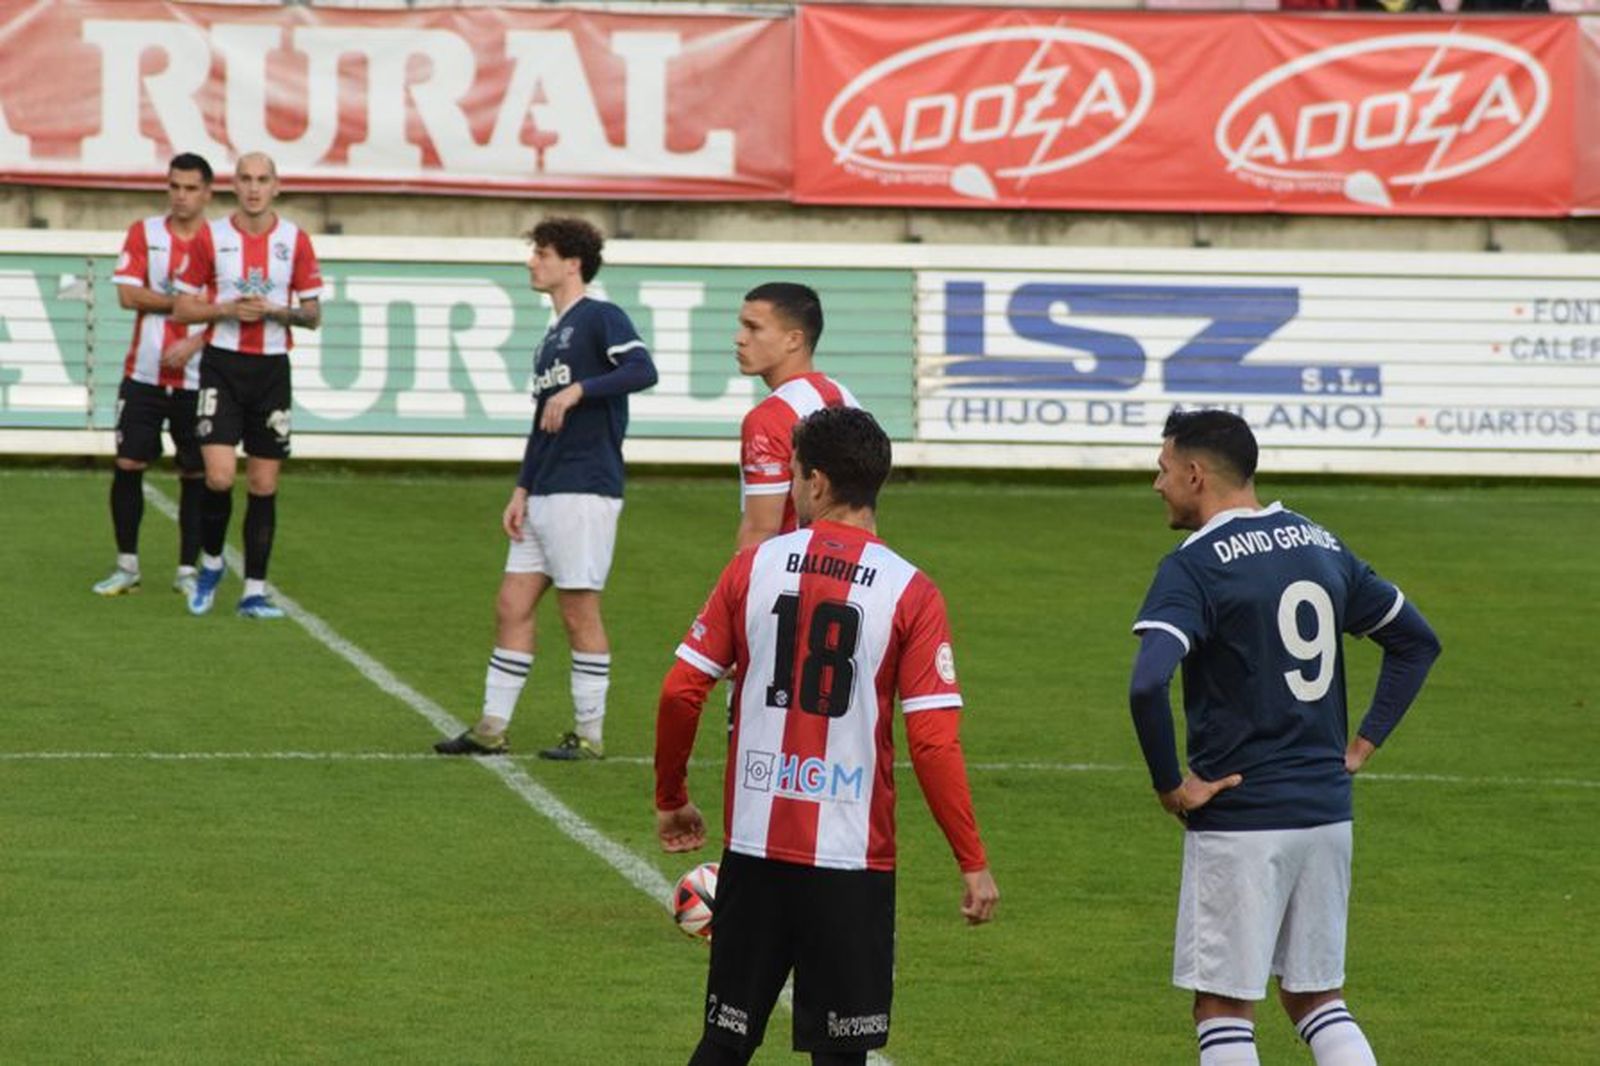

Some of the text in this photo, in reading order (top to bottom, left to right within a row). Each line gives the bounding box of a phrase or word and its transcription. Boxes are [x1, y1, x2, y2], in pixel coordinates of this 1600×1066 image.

[82, 20, 735, 174] RURAL
[835, 66, 1128, 162] ADOZA
[1227, 73, 1523, 168] ADOZA
[196, 387, 218, 416] 16
[1302, 368, 1378, 394] S.L.
[946, 398, 1067, 429] (HIJO
[1087, 400, 1145, 427] DE
[1434, 409, 1577, 436] CUARTOS
[1213, 524, 1341, 563] DAVID GRANDE
[786, 553, 876, 587] BALDRICH
[765, 590, 866, 719] 18
[1277, 580, 1337, 702] 9
[776, 752, 863, 799] HGM
